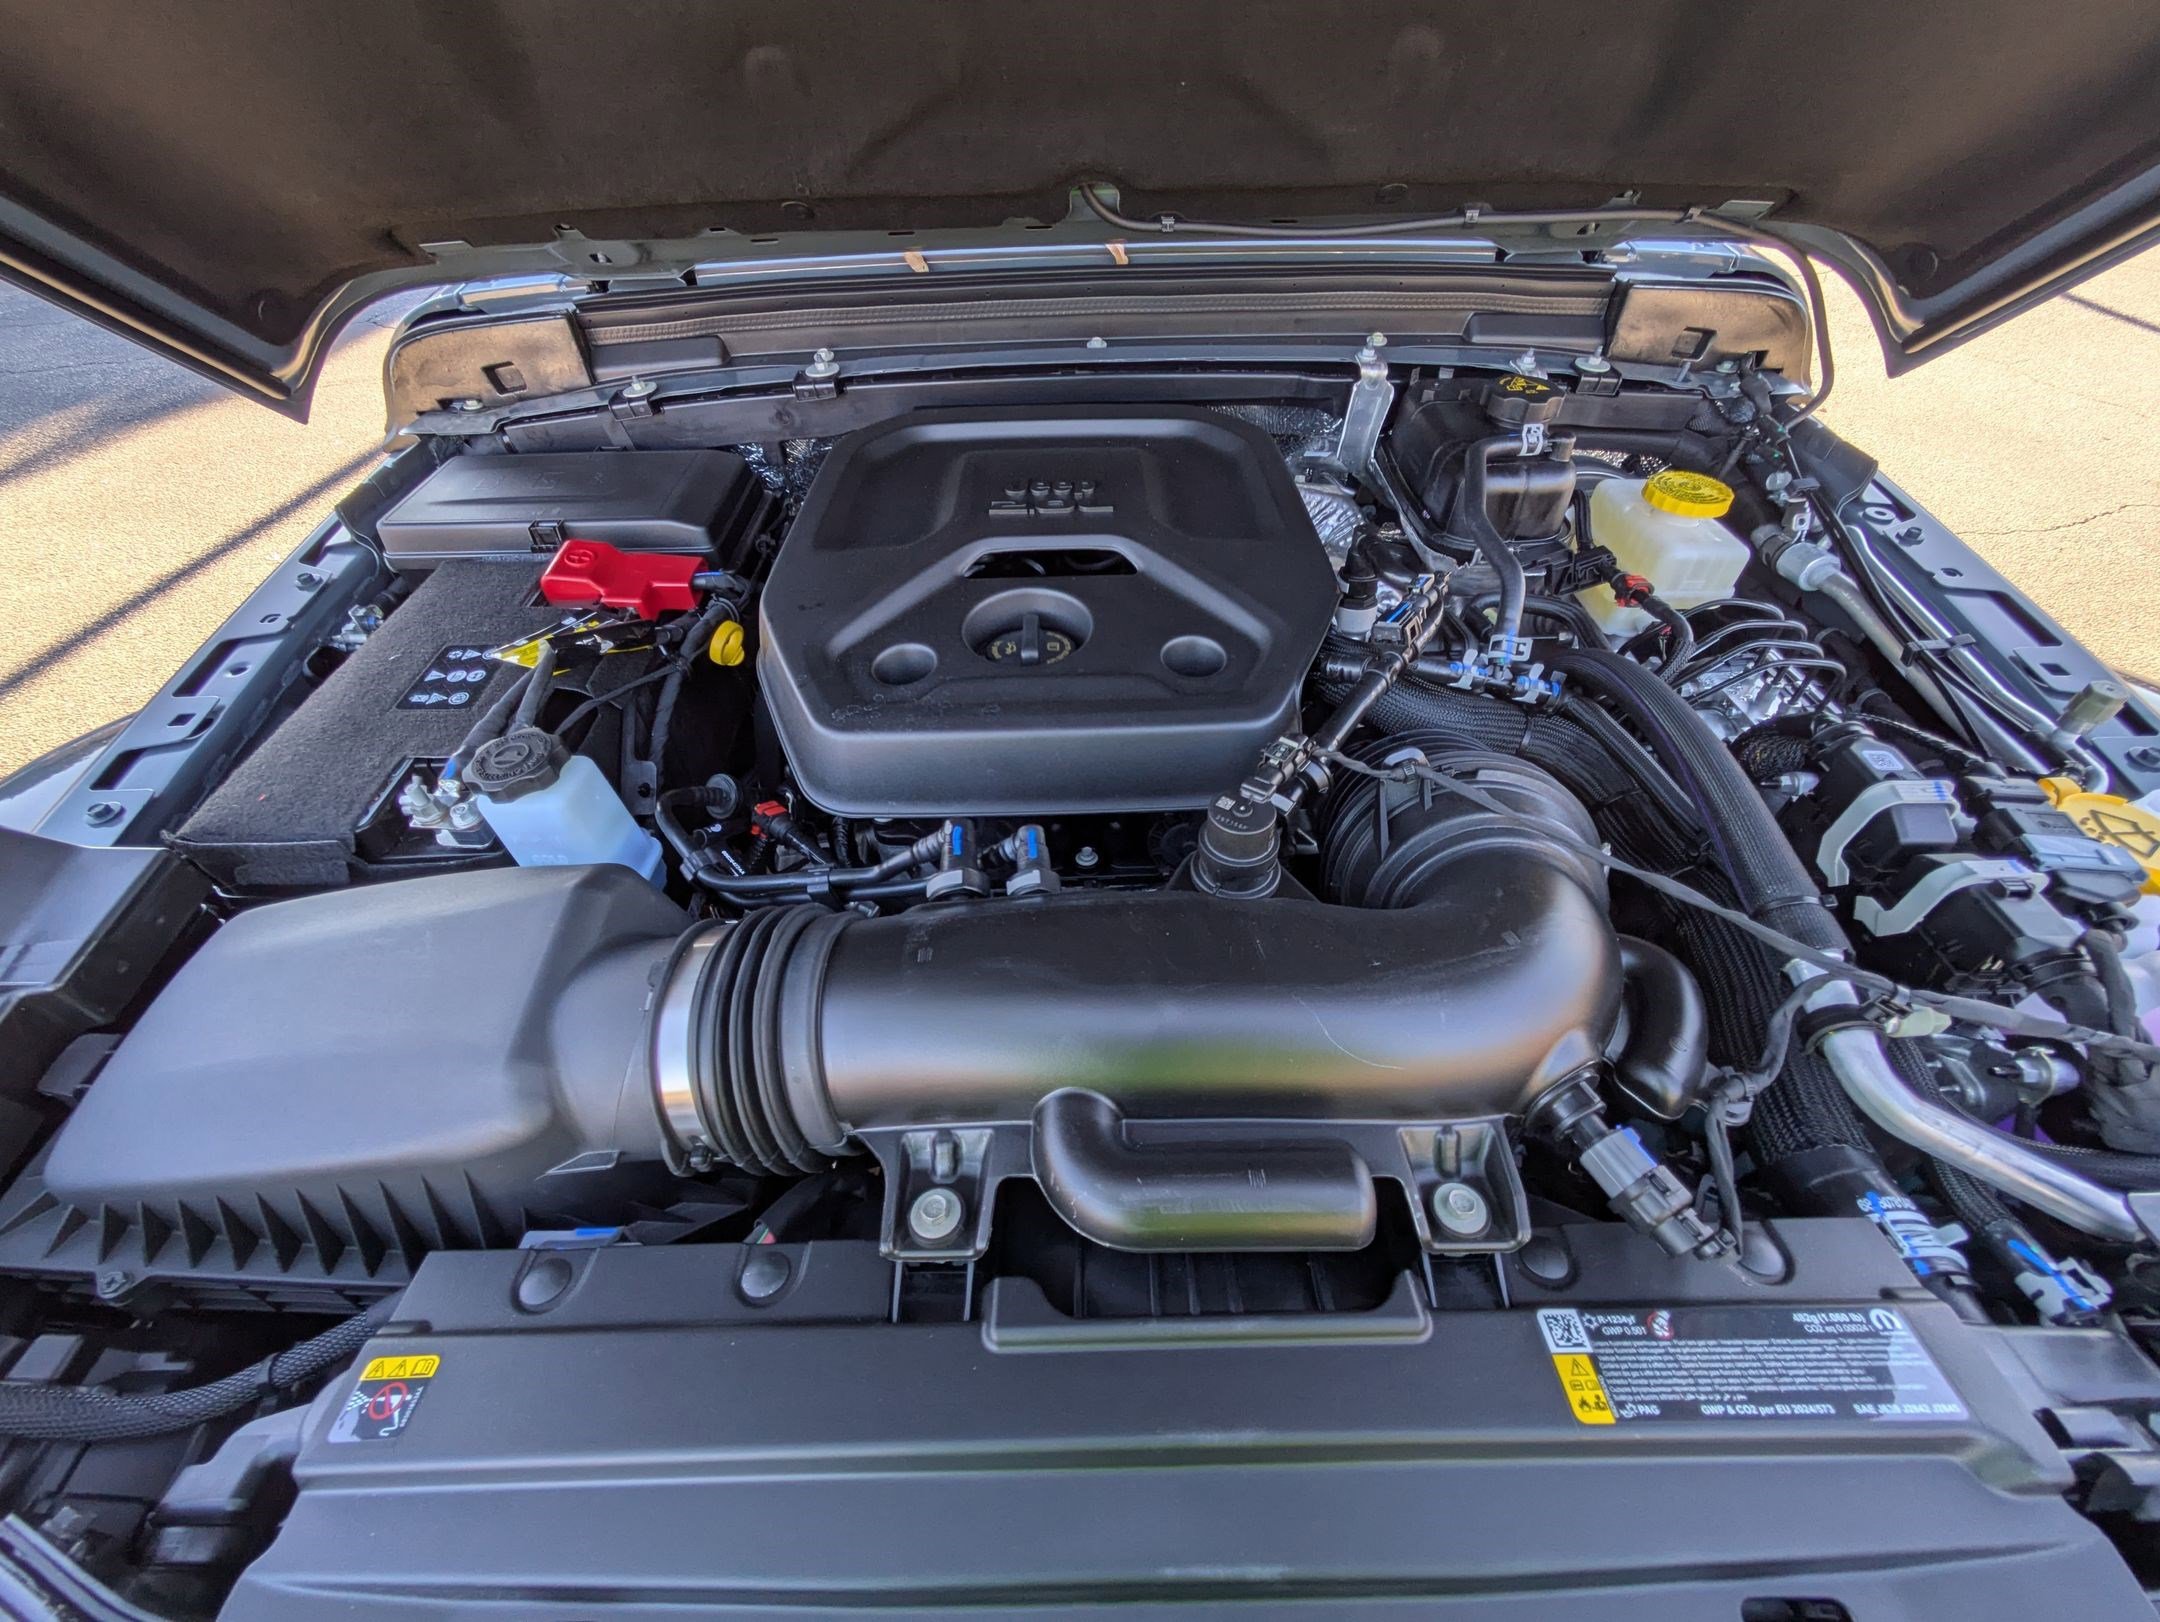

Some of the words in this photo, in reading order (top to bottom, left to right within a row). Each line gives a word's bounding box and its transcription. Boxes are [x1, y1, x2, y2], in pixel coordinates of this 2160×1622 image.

[1602, 1326, 1623, 1336] GWP
[1803, 1323, 1825, 1333] CO2
[1637, 1404, 1661, 1416] PAG
[1700, 1404, 1725, 1415] GWP
[1726, 1404, 1736, 1415] &
[1735, 1404, 1759, 1415] CO2
[1759, 1406, 1775, 1416] per
[1775, 1403, 1792, 1414] EU
